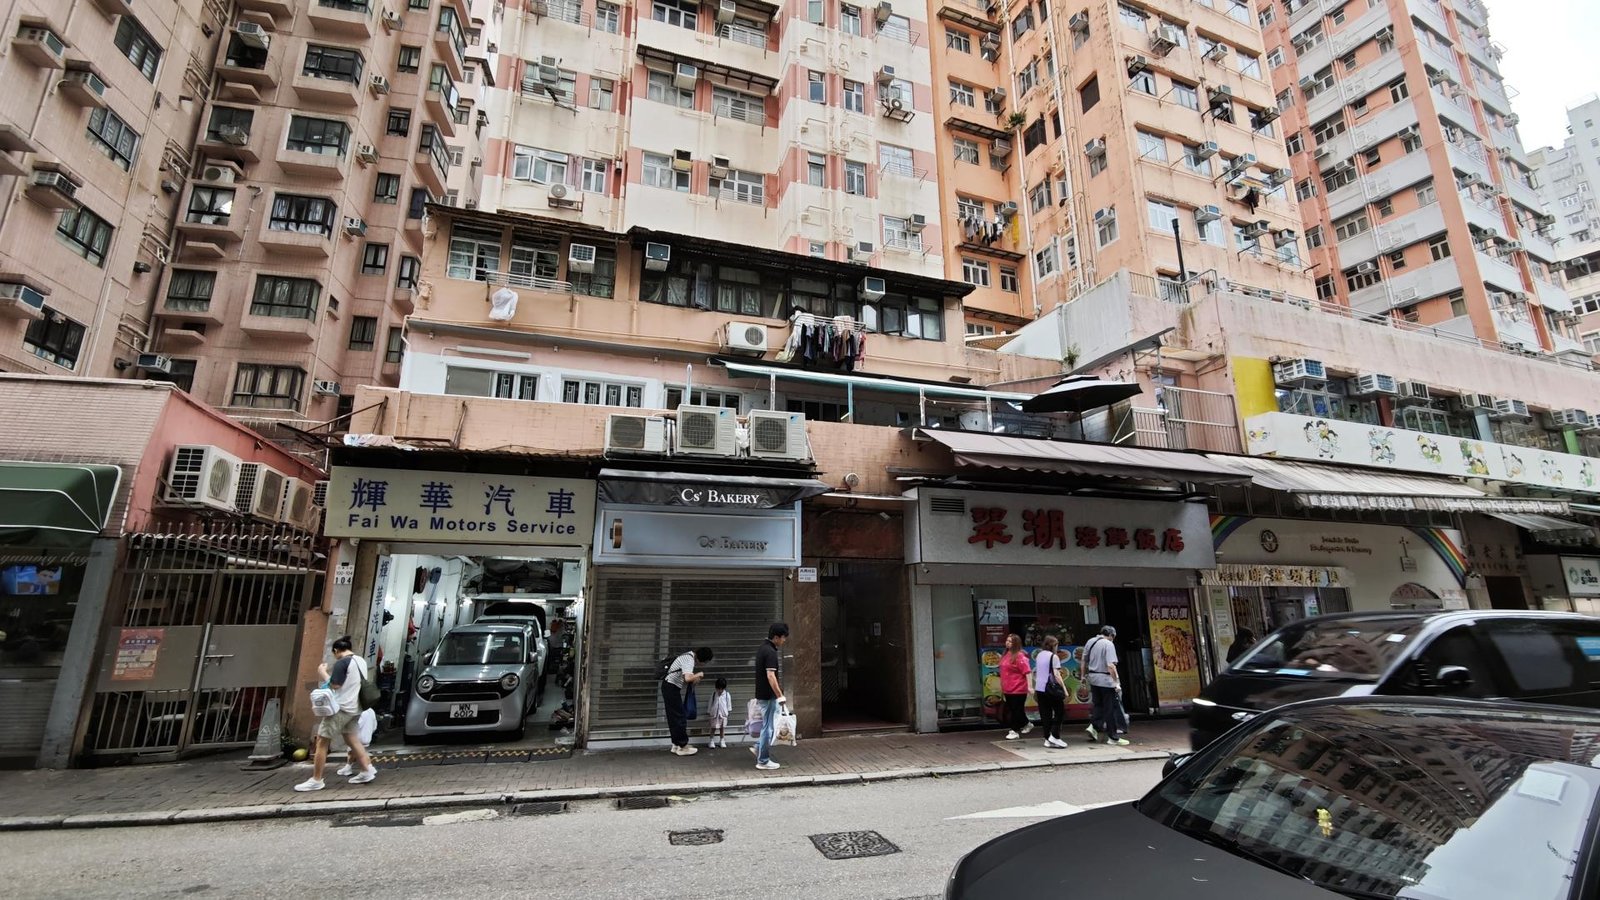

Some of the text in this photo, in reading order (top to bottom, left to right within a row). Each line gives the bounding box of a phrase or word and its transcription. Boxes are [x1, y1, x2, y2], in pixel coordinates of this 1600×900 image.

[349, 478, 576, 519] 輝華汽車
[681, 488, 702, 502] Cs'
[348, 513, 576, 535] Fai Wa Motors Service
